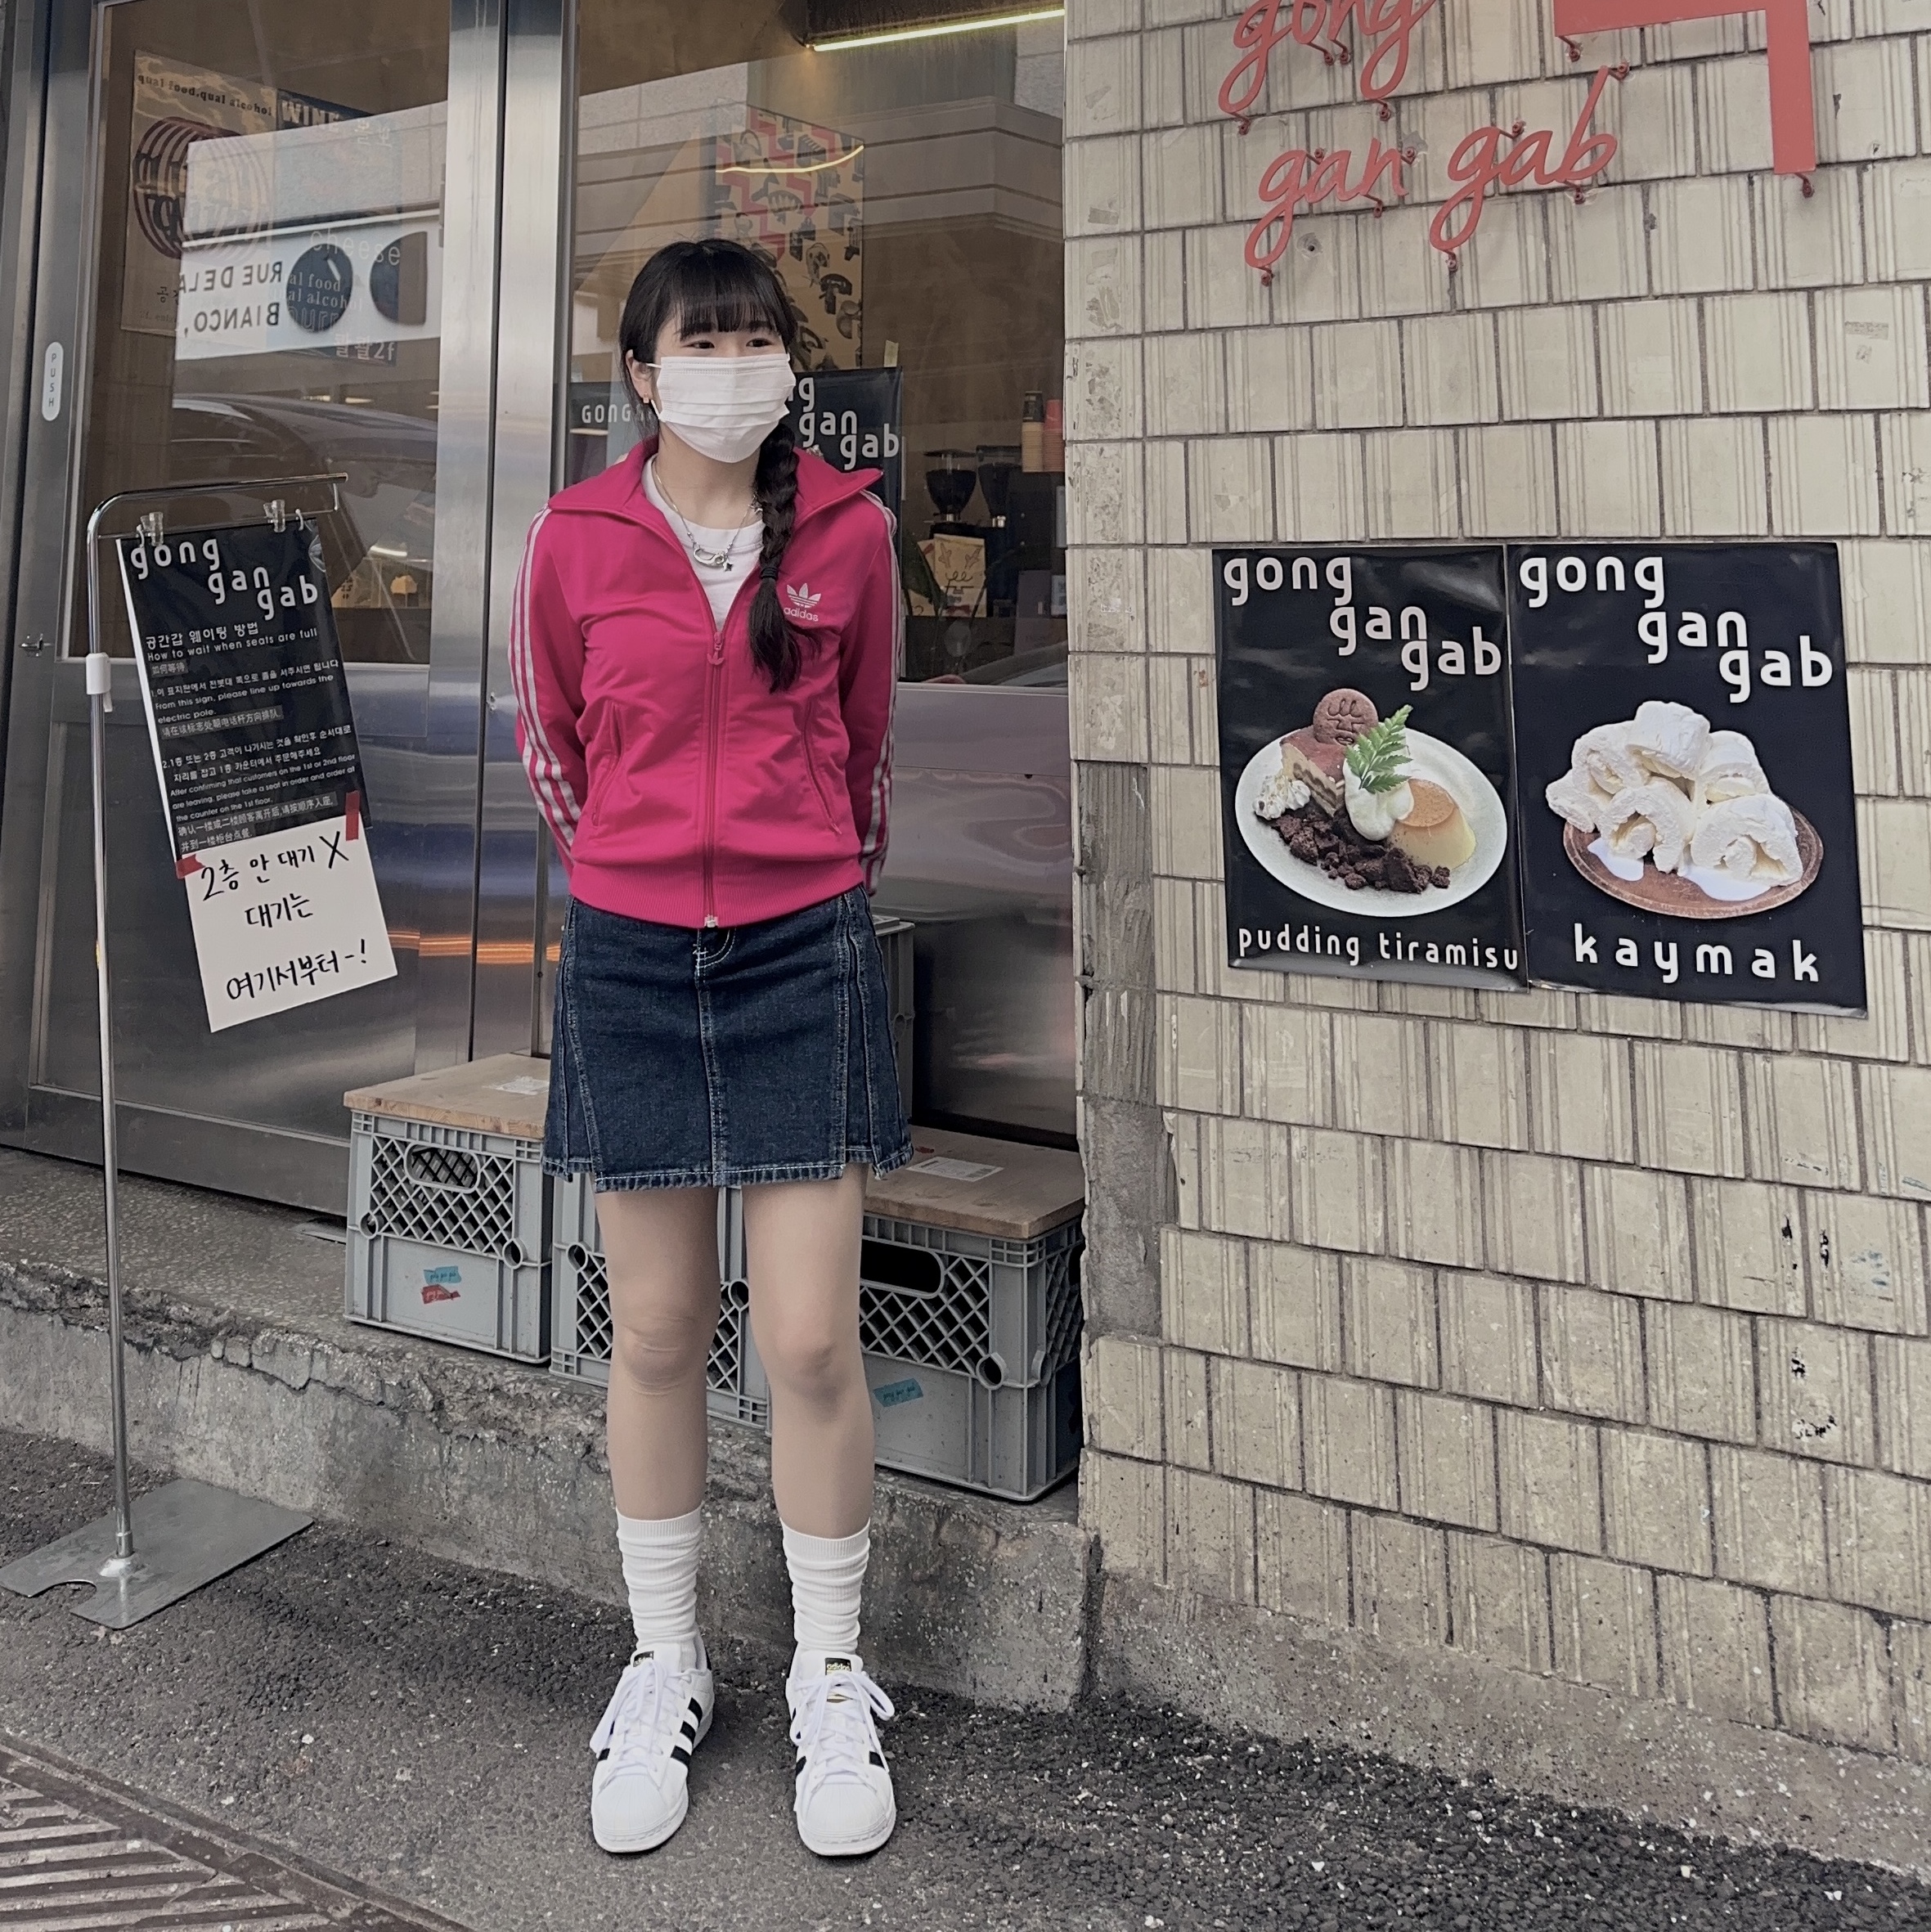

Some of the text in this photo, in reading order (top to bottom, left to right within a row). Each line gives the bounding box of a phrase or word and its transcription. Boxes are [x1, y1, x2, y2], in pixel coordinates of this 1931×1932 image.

[1219, 0, 1436, 113] gong
[1244, 65, 1619, 268] gan gab
[308, 273, 341, 292] food
[48, 353, 57, 407] PUSH
[798, 410, 857, 448] gan
[839, 423, 900, 471] gab
[130, 538, 219, 580] gong
[1224, 557, 1352, 606] gong
[207, 566, 272, 604] gan
[254, 574, 318, 620] gab
[1520, 556, 1664, 609] gong
[145, 621, 258, 650] 공간갑 웨이팅 방법
[784, 607, 819, 622] adidas
[1330, 606, 1427, 656] gan
[1637, 611, 1748, 664] gan
[146, 627, 317, 661] How to wait when seats are full
[1401, 626, 1502, 691] gab
[155, 701, 176, 710] From
[177, 698, 193, 706] this
[217, 690, 248, 701] please
[249, 686, 266, 694] line
[281, 676, 317, 689] towards
[317, 674, 334, 682] the
[1719, 635, 1833, 703] gab
[157, 712, 191, 724] electric
[169, 788, 187, 797] After
[309, 771, 325, 781] and
[175, 814, 188, 822] the
[230, 802, 242, 811] the
[200, 830, 349, 901] 2층 안 대기 X
[244, 892, 314, 928] 대기는
[1239, 923, 1519, 970] pudding tiramisu
[1574, 923, 1820, 984] kaymak
